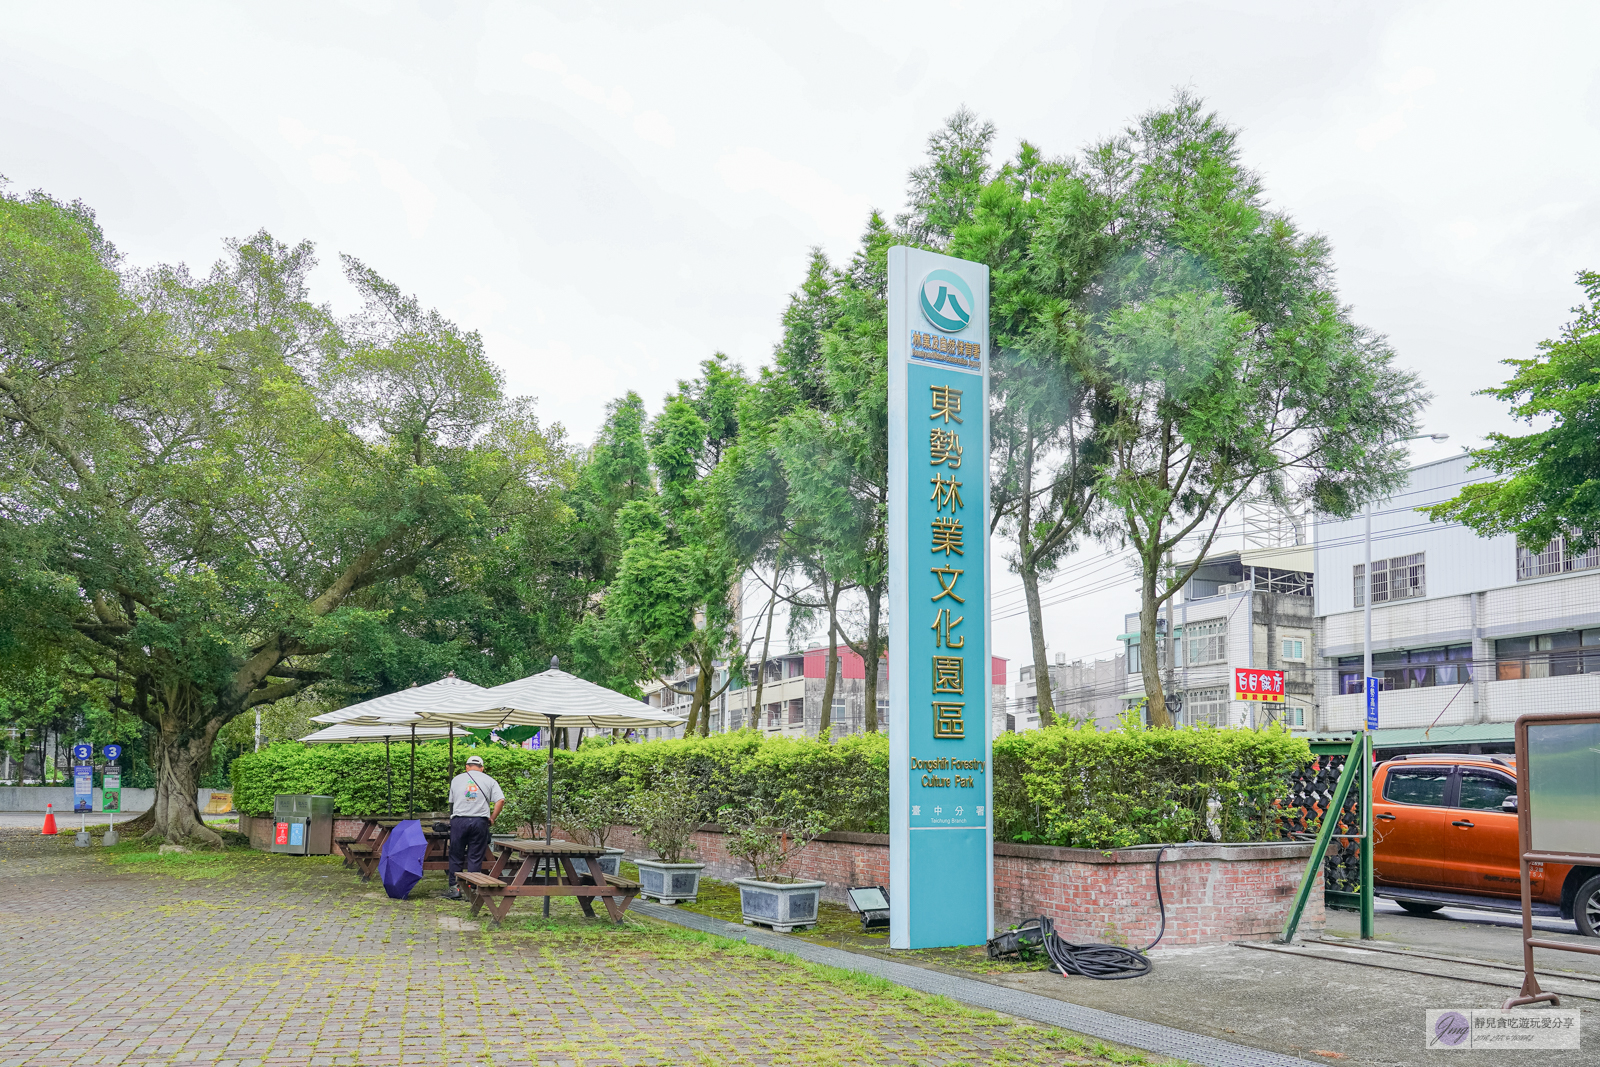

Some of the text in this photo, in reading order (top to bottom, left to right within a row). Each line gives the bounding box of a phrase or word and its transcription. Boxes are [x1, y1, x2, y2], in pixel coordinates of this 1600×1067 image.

[912, 330, 981, 359] 林業及自然保育署
[930, 384, 966, 740] 東勢林業文化園區
[79, 747, 88, 758] 3
[108, 746, 117, 757] 3
[911, 756, 985, 774] Dongshih Forestry
[921, 774, 974, 788] Culture Park
[931, 817, 951, 825] Taichung
